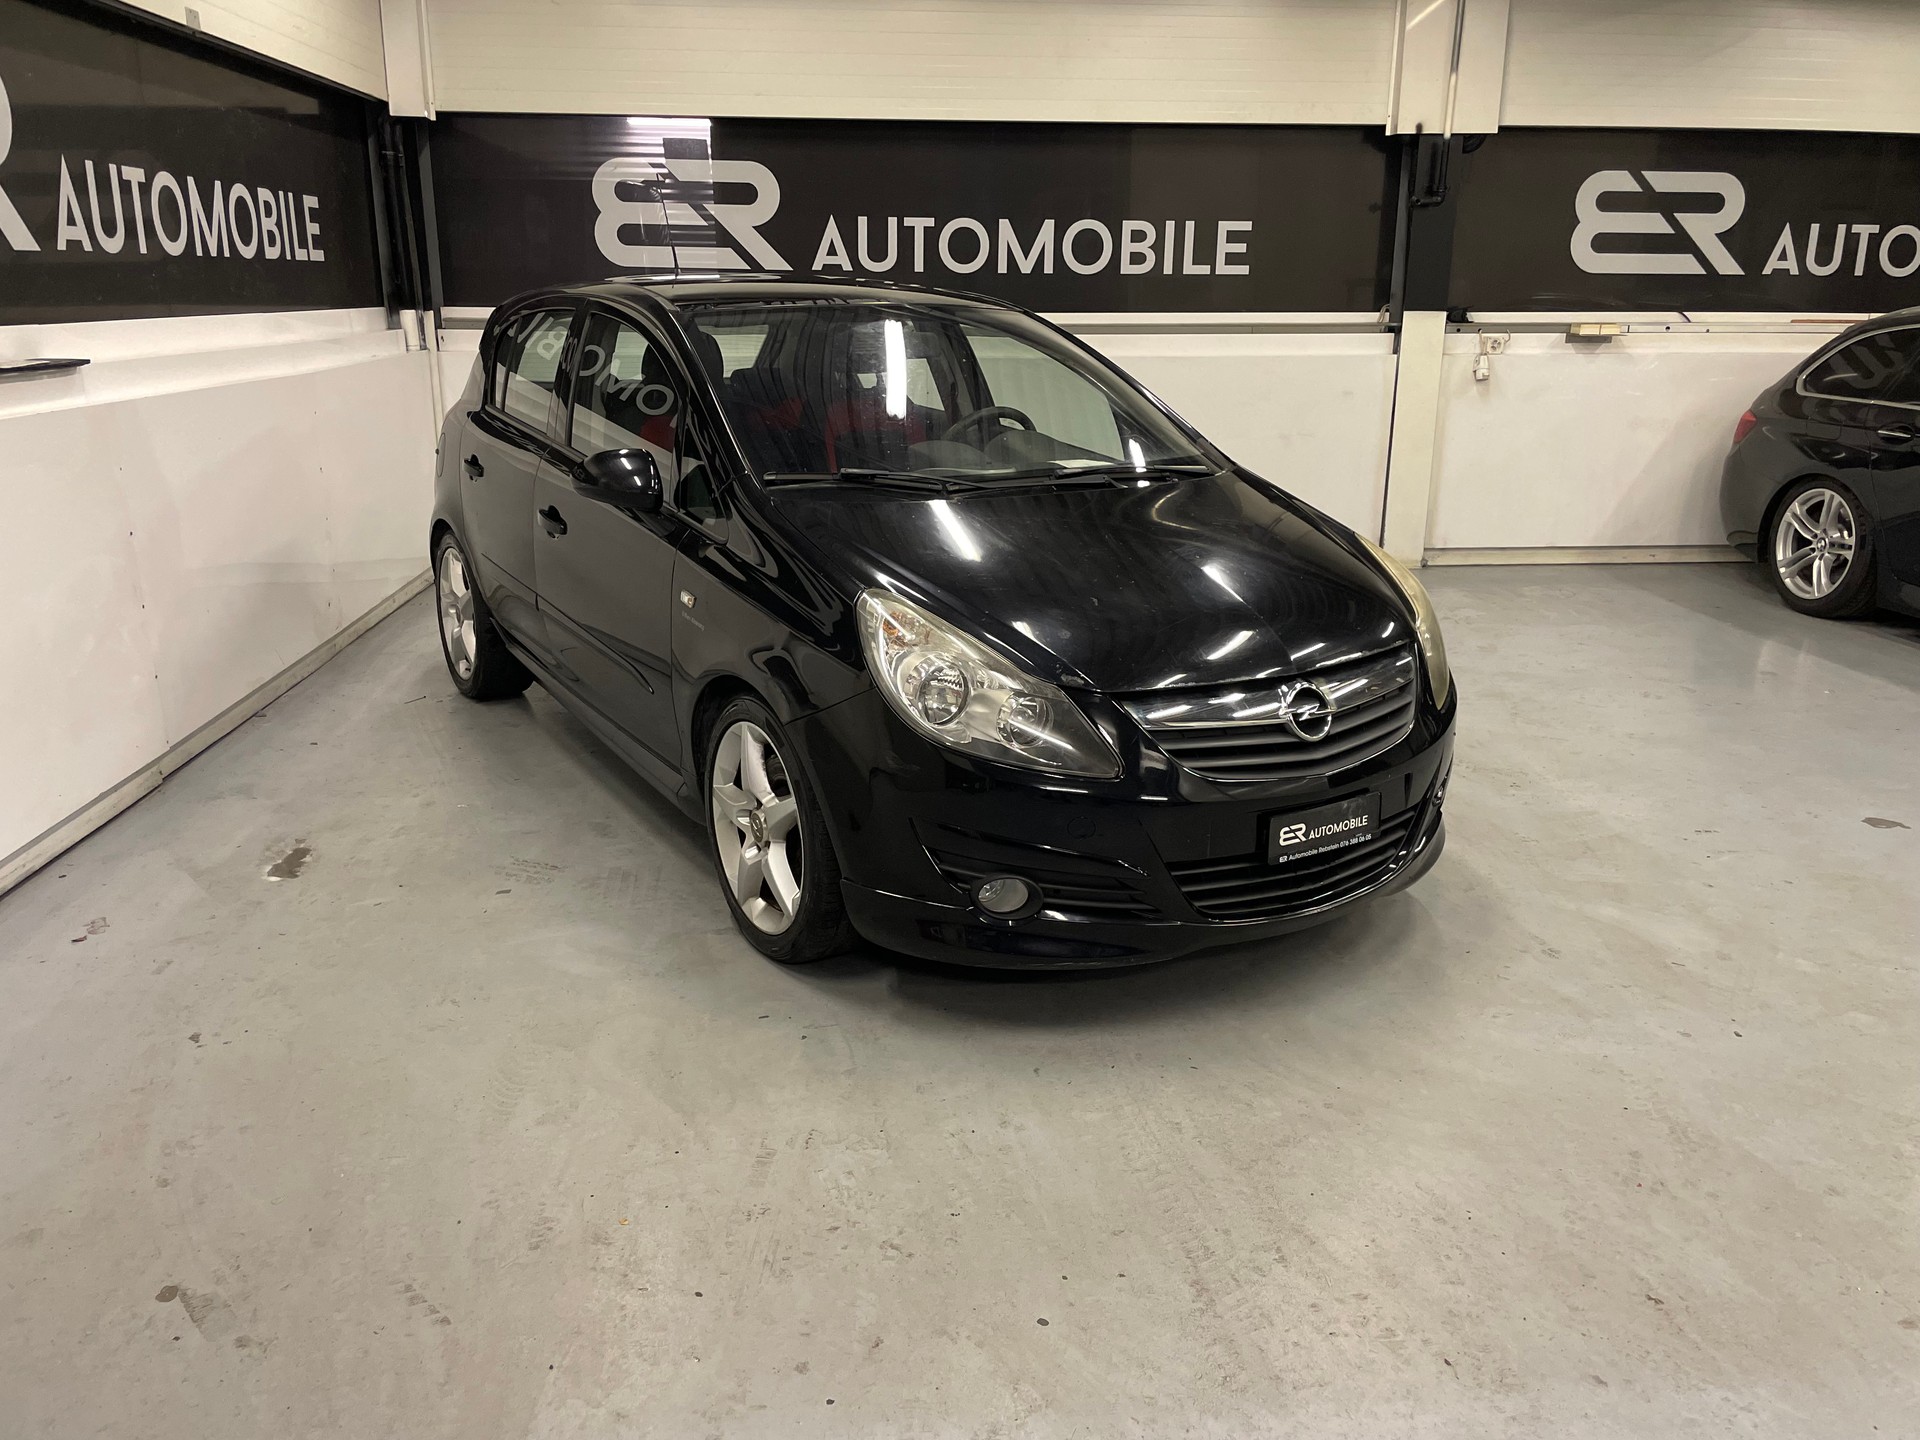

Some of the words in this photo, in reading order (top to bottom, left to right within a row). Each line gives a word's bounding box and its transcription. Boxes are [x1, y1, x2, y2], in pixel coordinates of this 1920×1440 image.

[57, 153, 325, 262] AUTOMOBILE
[811, 213, 1254, 275] AUTOMOBILE
[1761, 222, 1920, 277] AUTO
[1288, 848, 1318, 860] Automobile
[1318, 843, 1340, 853] Rebstein
[1358, 835, 1365, 843] 06
[1308, 815, 1369, 840] AUTOMOBILE
